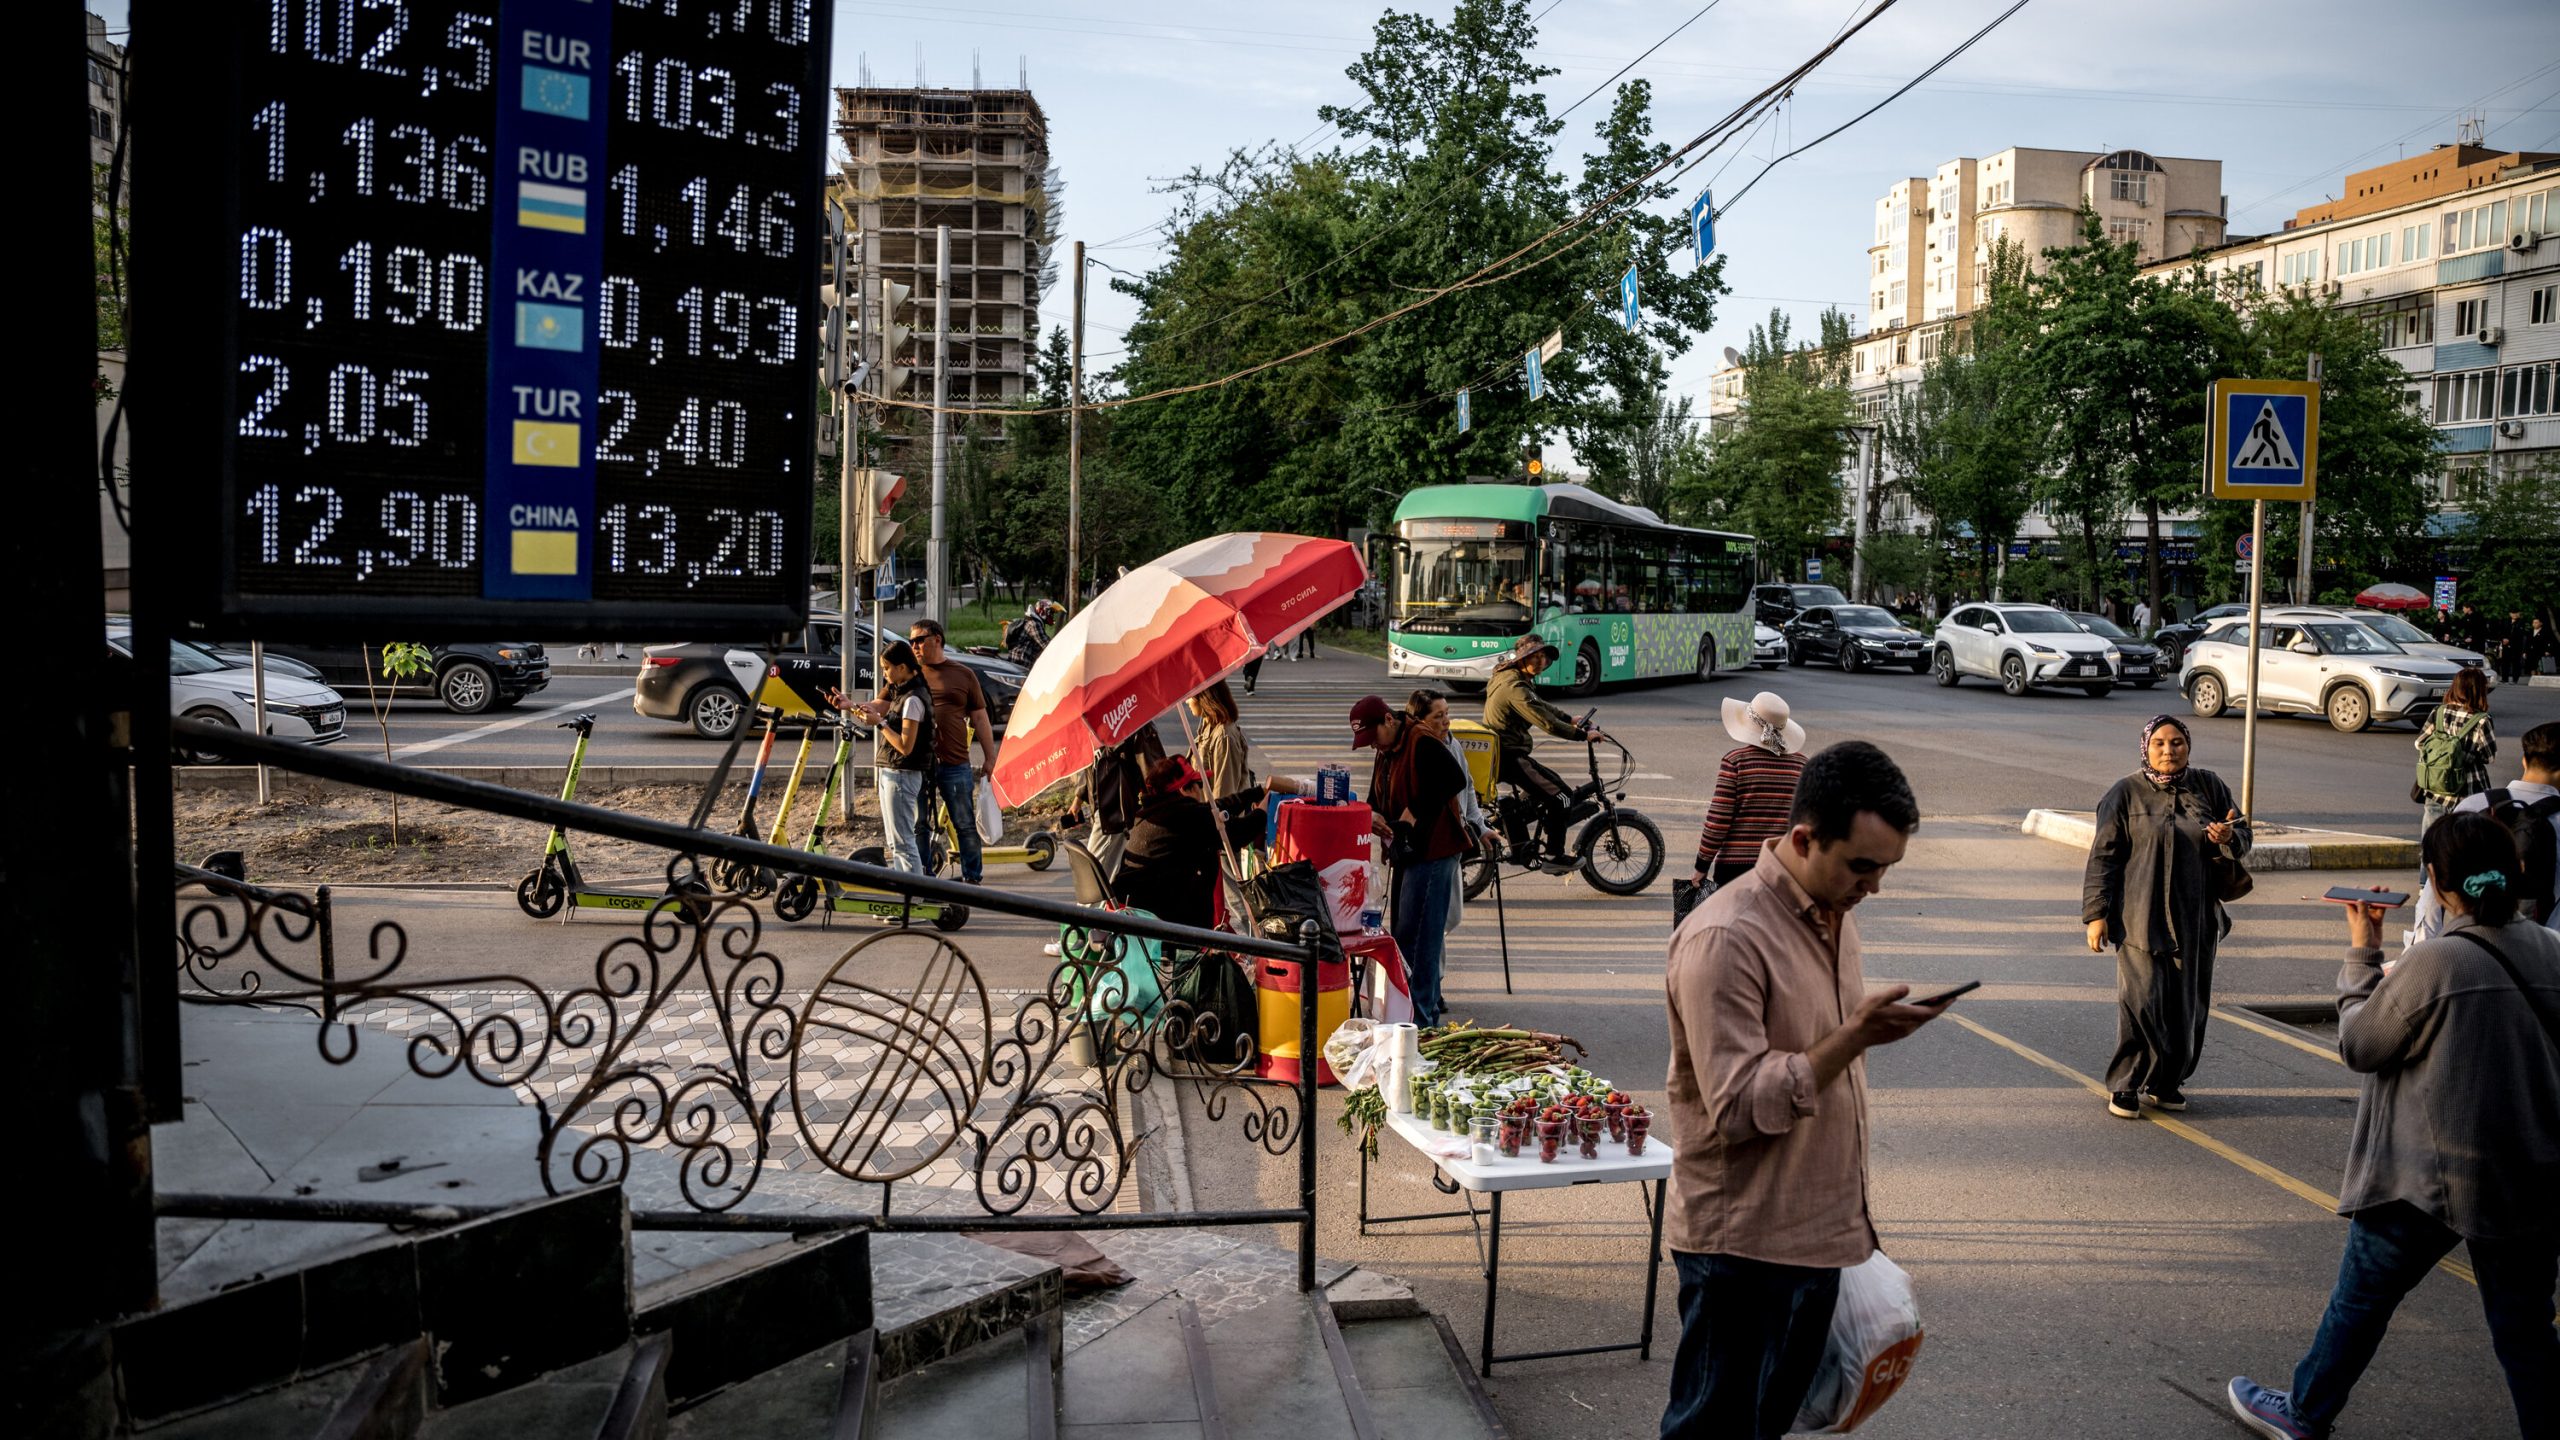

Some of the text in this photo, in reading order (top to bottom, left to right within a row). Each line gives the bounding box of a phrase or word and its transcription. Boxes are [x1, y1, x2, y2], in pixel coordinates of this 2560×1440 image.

[272, 0, 493, 97] 102,5
[522, 29, 591, 69] EUR
[253, 100, 796, 258] 1,136 RUB 1,146
[241, 226, 797, 365] 0,190 KAZ 0,193
[240, 355, 747, 477] 2,05 TUR 2,40
[247, 484, 783, 588] 12,90 CHINA 13,20
[1281, 585, 1318, 611] ЭТО СИЛА
[1480, 640, 1499, 649] 0070
[769, 666, 777, 676] Я
[792, 659, 811, 669] 776
